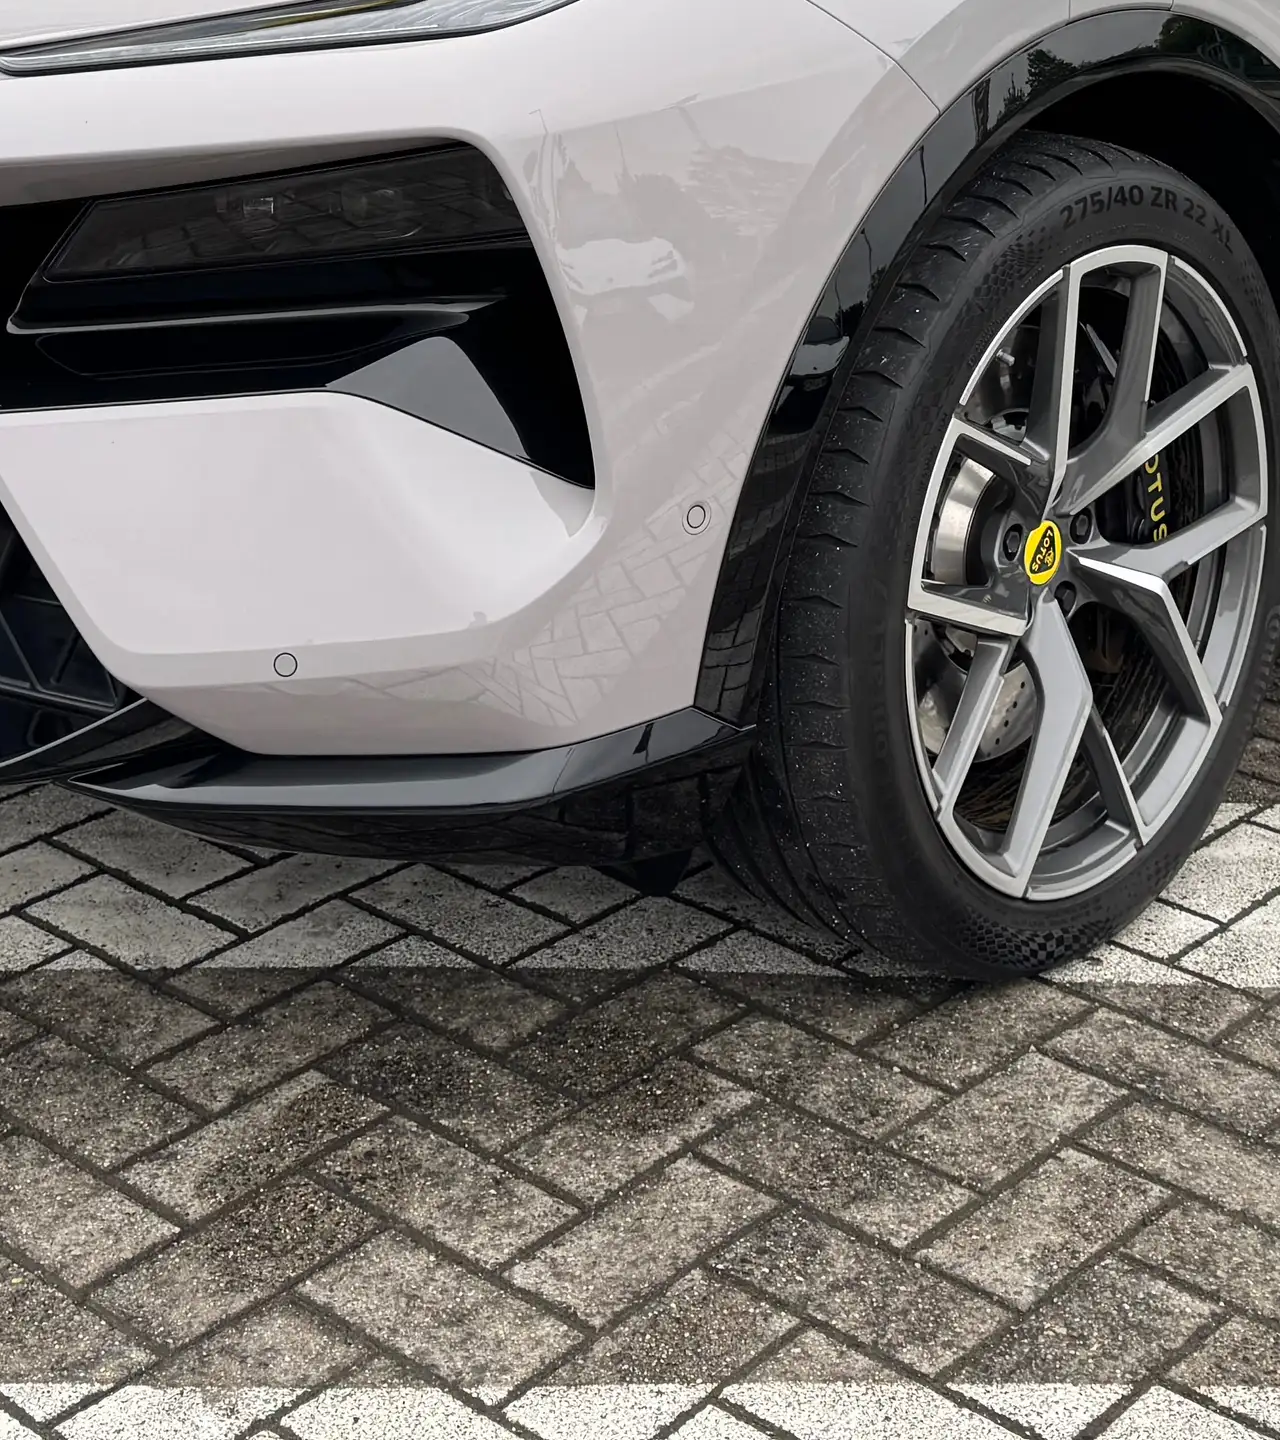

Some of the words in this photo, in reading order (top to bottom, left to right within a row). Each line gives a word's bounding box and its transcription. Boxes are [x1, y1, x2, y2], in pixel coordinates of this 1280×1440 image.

[1060, 184, 1144, 230] 275/40
[1150, 186, 1178, 212] ZR
[1183, 196, 1207, 228] 22
[1212, 216, 1234, 254] XL
[1144, 454, 1168, 542] OTUS
[1031, 529, 1054, 572] LOTUS
